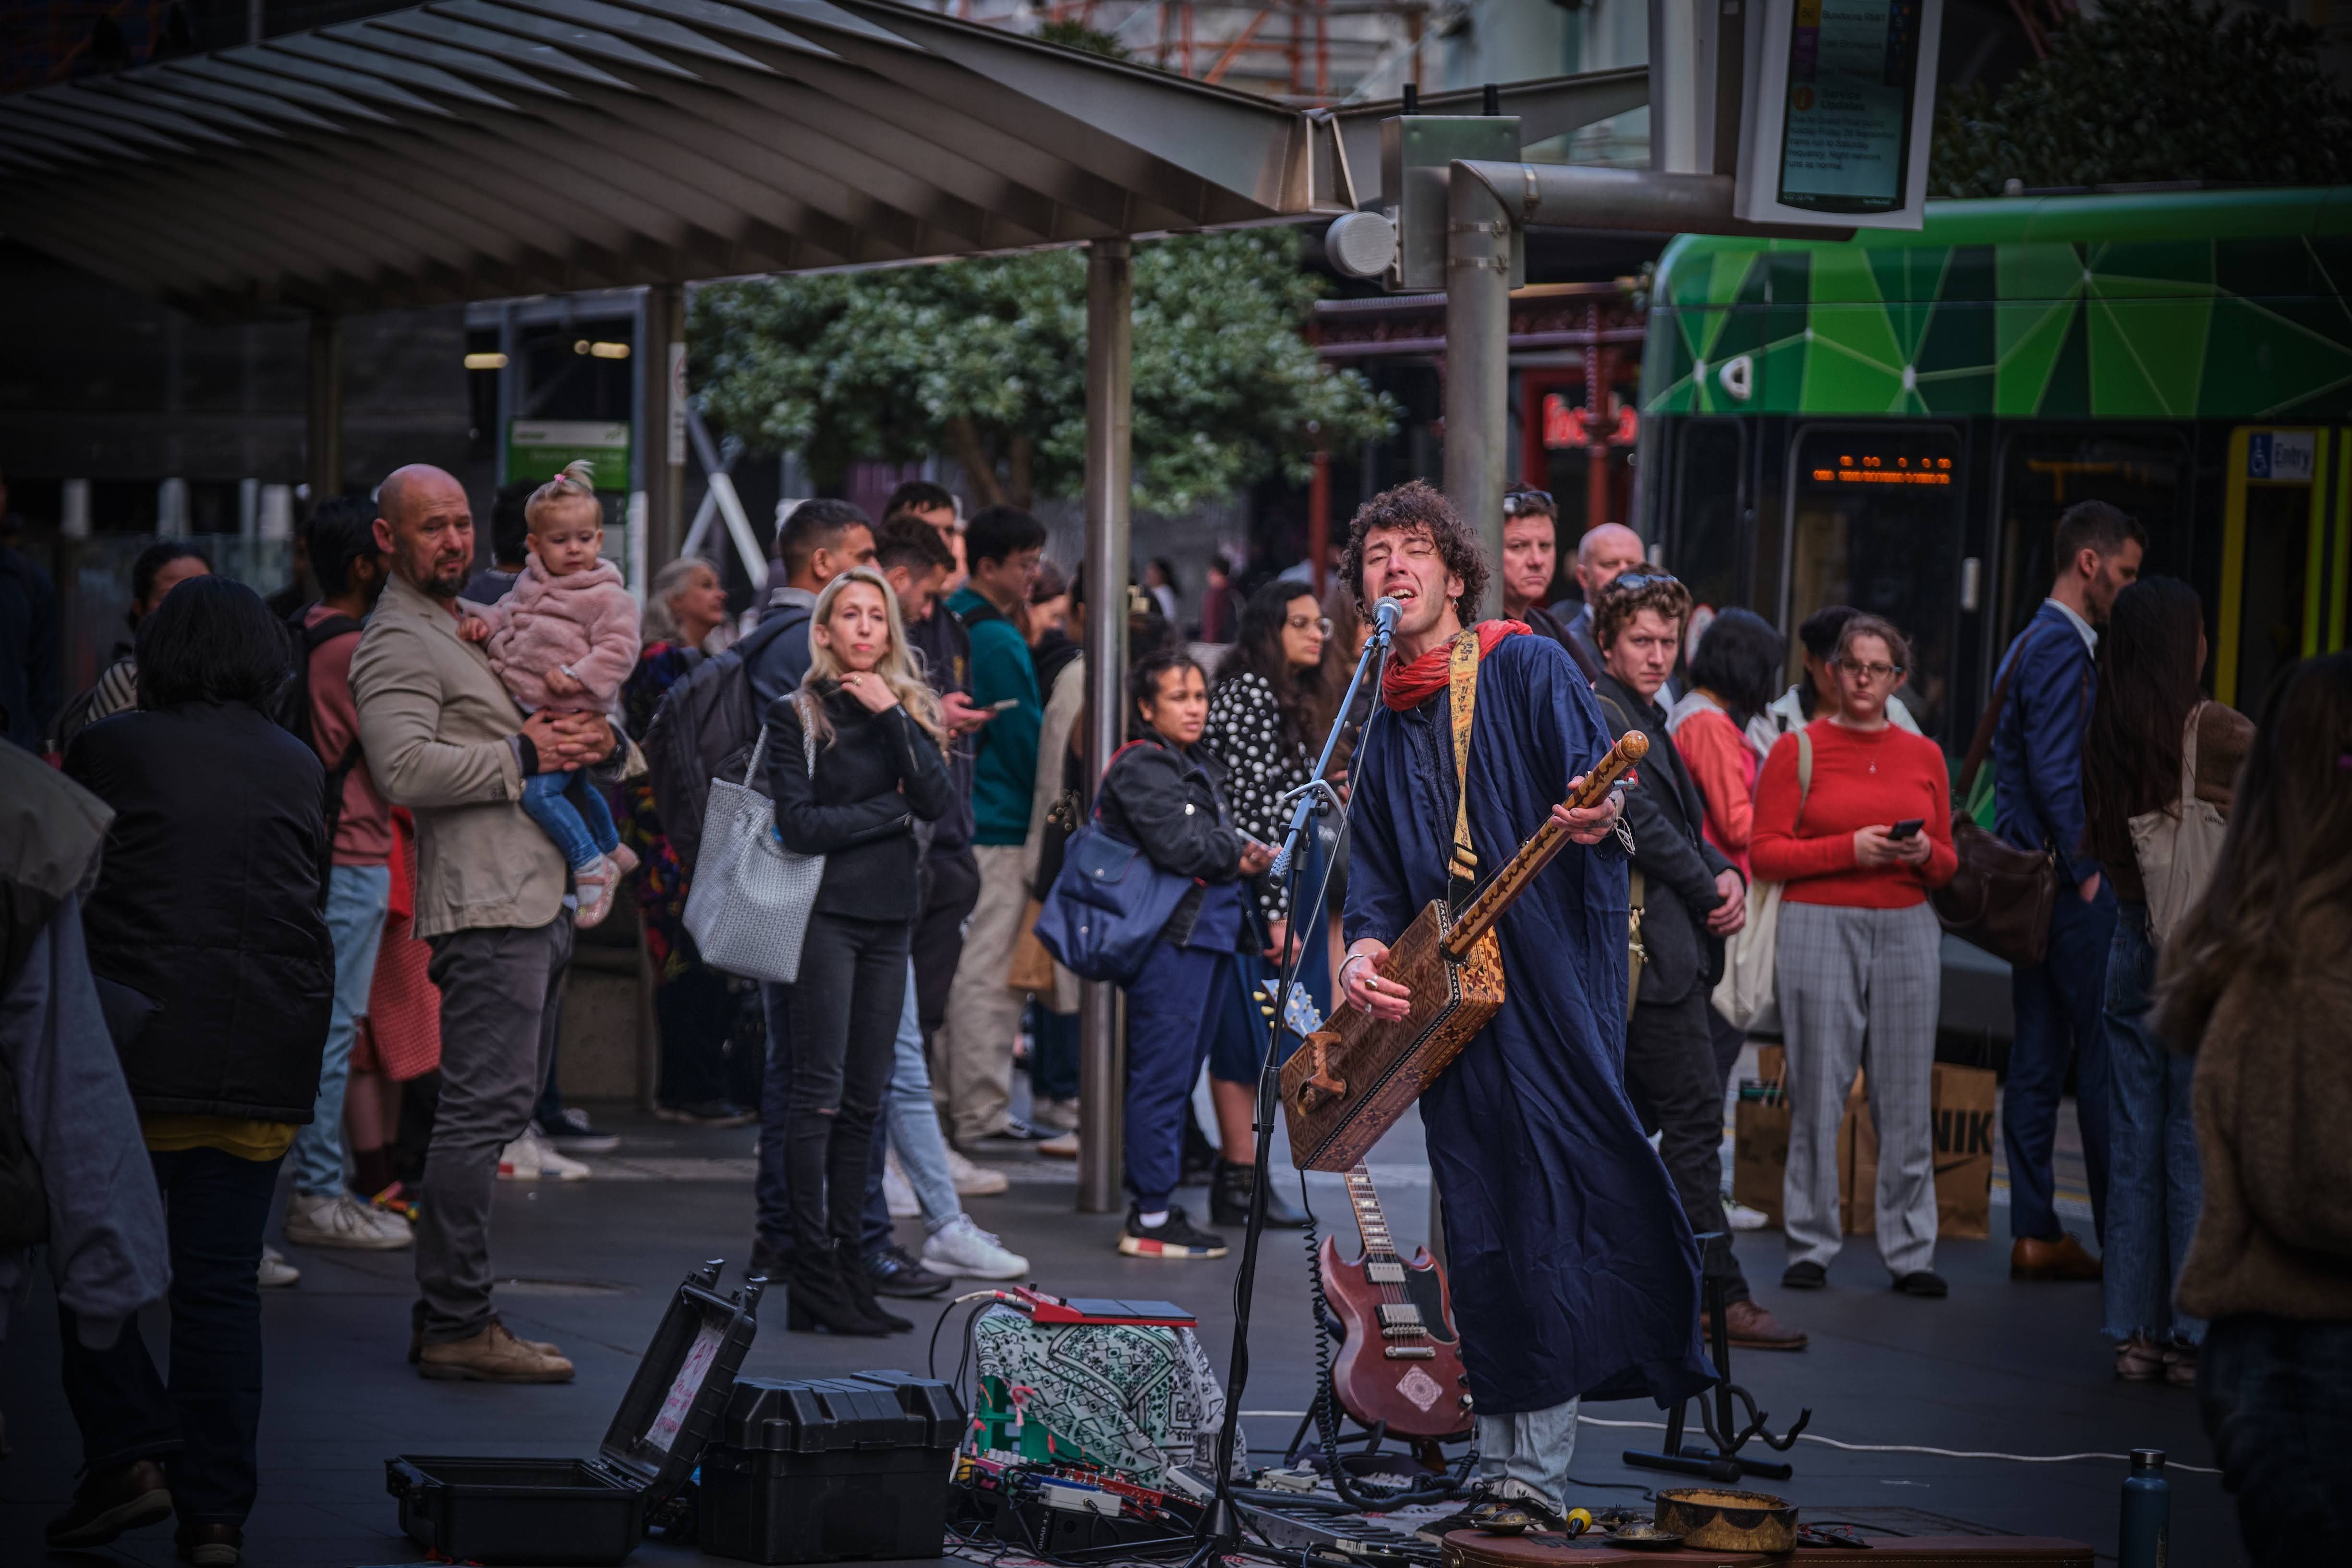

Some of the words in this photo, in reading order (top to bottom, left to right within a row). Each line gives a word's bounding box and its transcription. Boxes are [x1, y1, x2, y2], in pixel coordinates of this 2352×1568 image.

[1822, 89, 1862, 99] Service
[1821, 99, 1866, 110] Updates
[2274, 442, 2311, 473] Entry
[1037, 1526, 1046, 1550] QUAD
